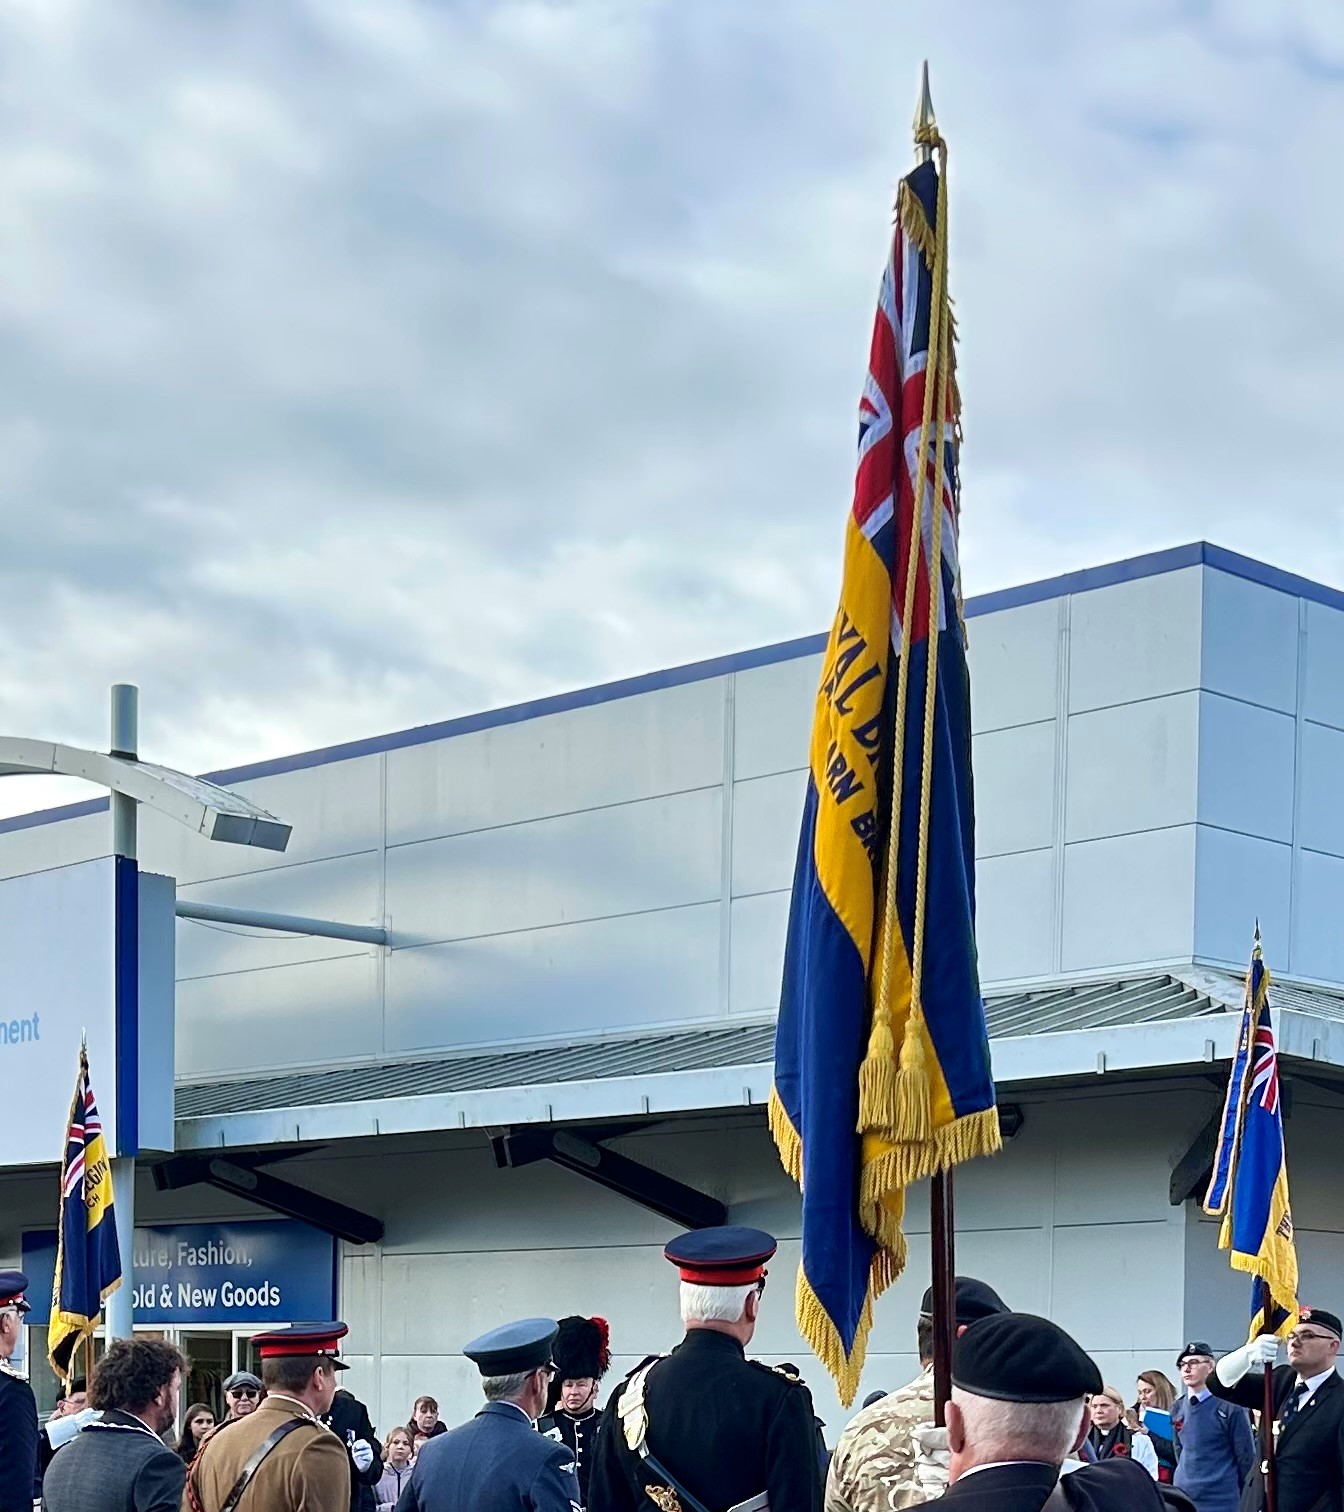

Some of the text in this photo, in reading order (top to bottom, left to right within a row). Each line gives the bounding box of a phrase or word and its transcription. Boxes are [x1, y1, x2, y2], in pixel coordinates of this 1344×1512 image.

[177, 1239, 253, 1268] Fashion,
[159, 1283, 174, 1309] &
[177, 1281, 218, 1309] New
[220, 1280, 281, 1308] Goods
